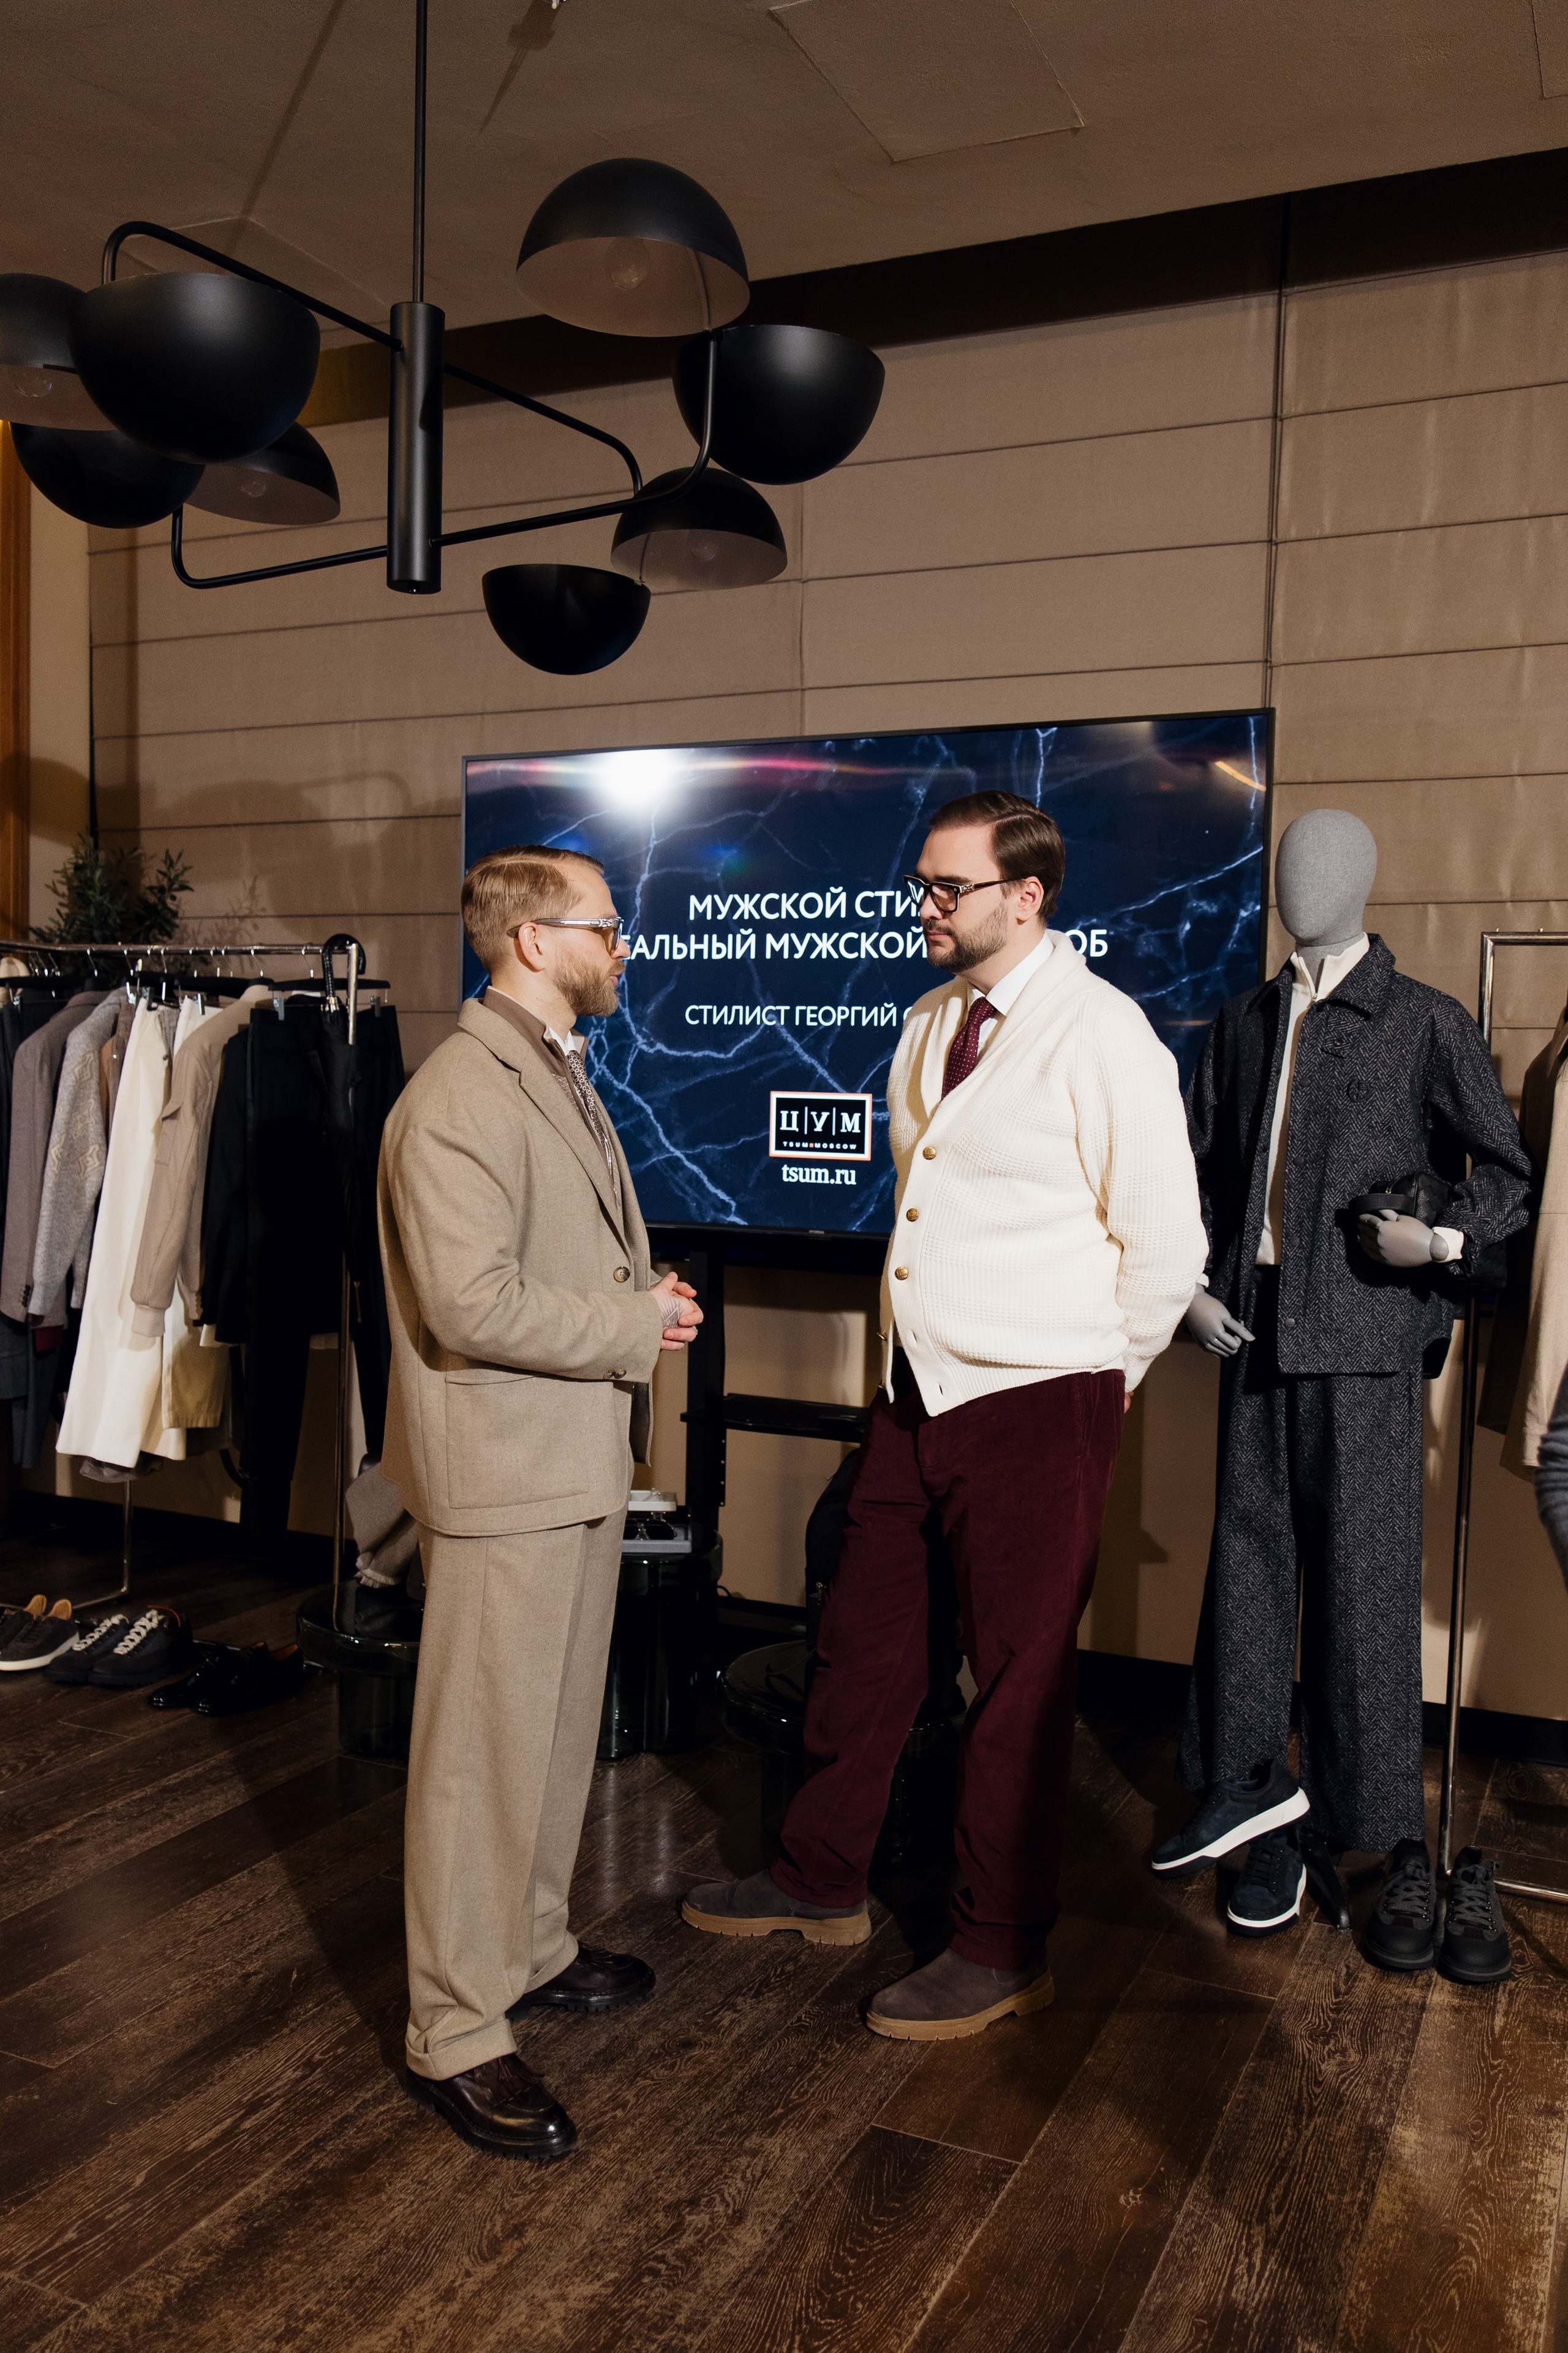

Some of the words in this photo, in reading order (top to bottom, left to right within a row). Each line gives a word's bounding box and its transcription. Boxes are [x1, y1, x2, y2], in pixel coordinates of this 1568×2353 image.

[689, 886, 846, 921] МУЖСКОЙ
[854, 890, 921, 918] СТИ
[766, 926, 928, 959] МУЖСКОЙ
[685, 1005, 790, 1025] СТИЛИСТ
[795, 1002, 897, 1027] ГЕОРГИЙ
[814, 1142, 857, 1150] MOSCOW
[781, 1164, 857, 1185] tsum.ru
